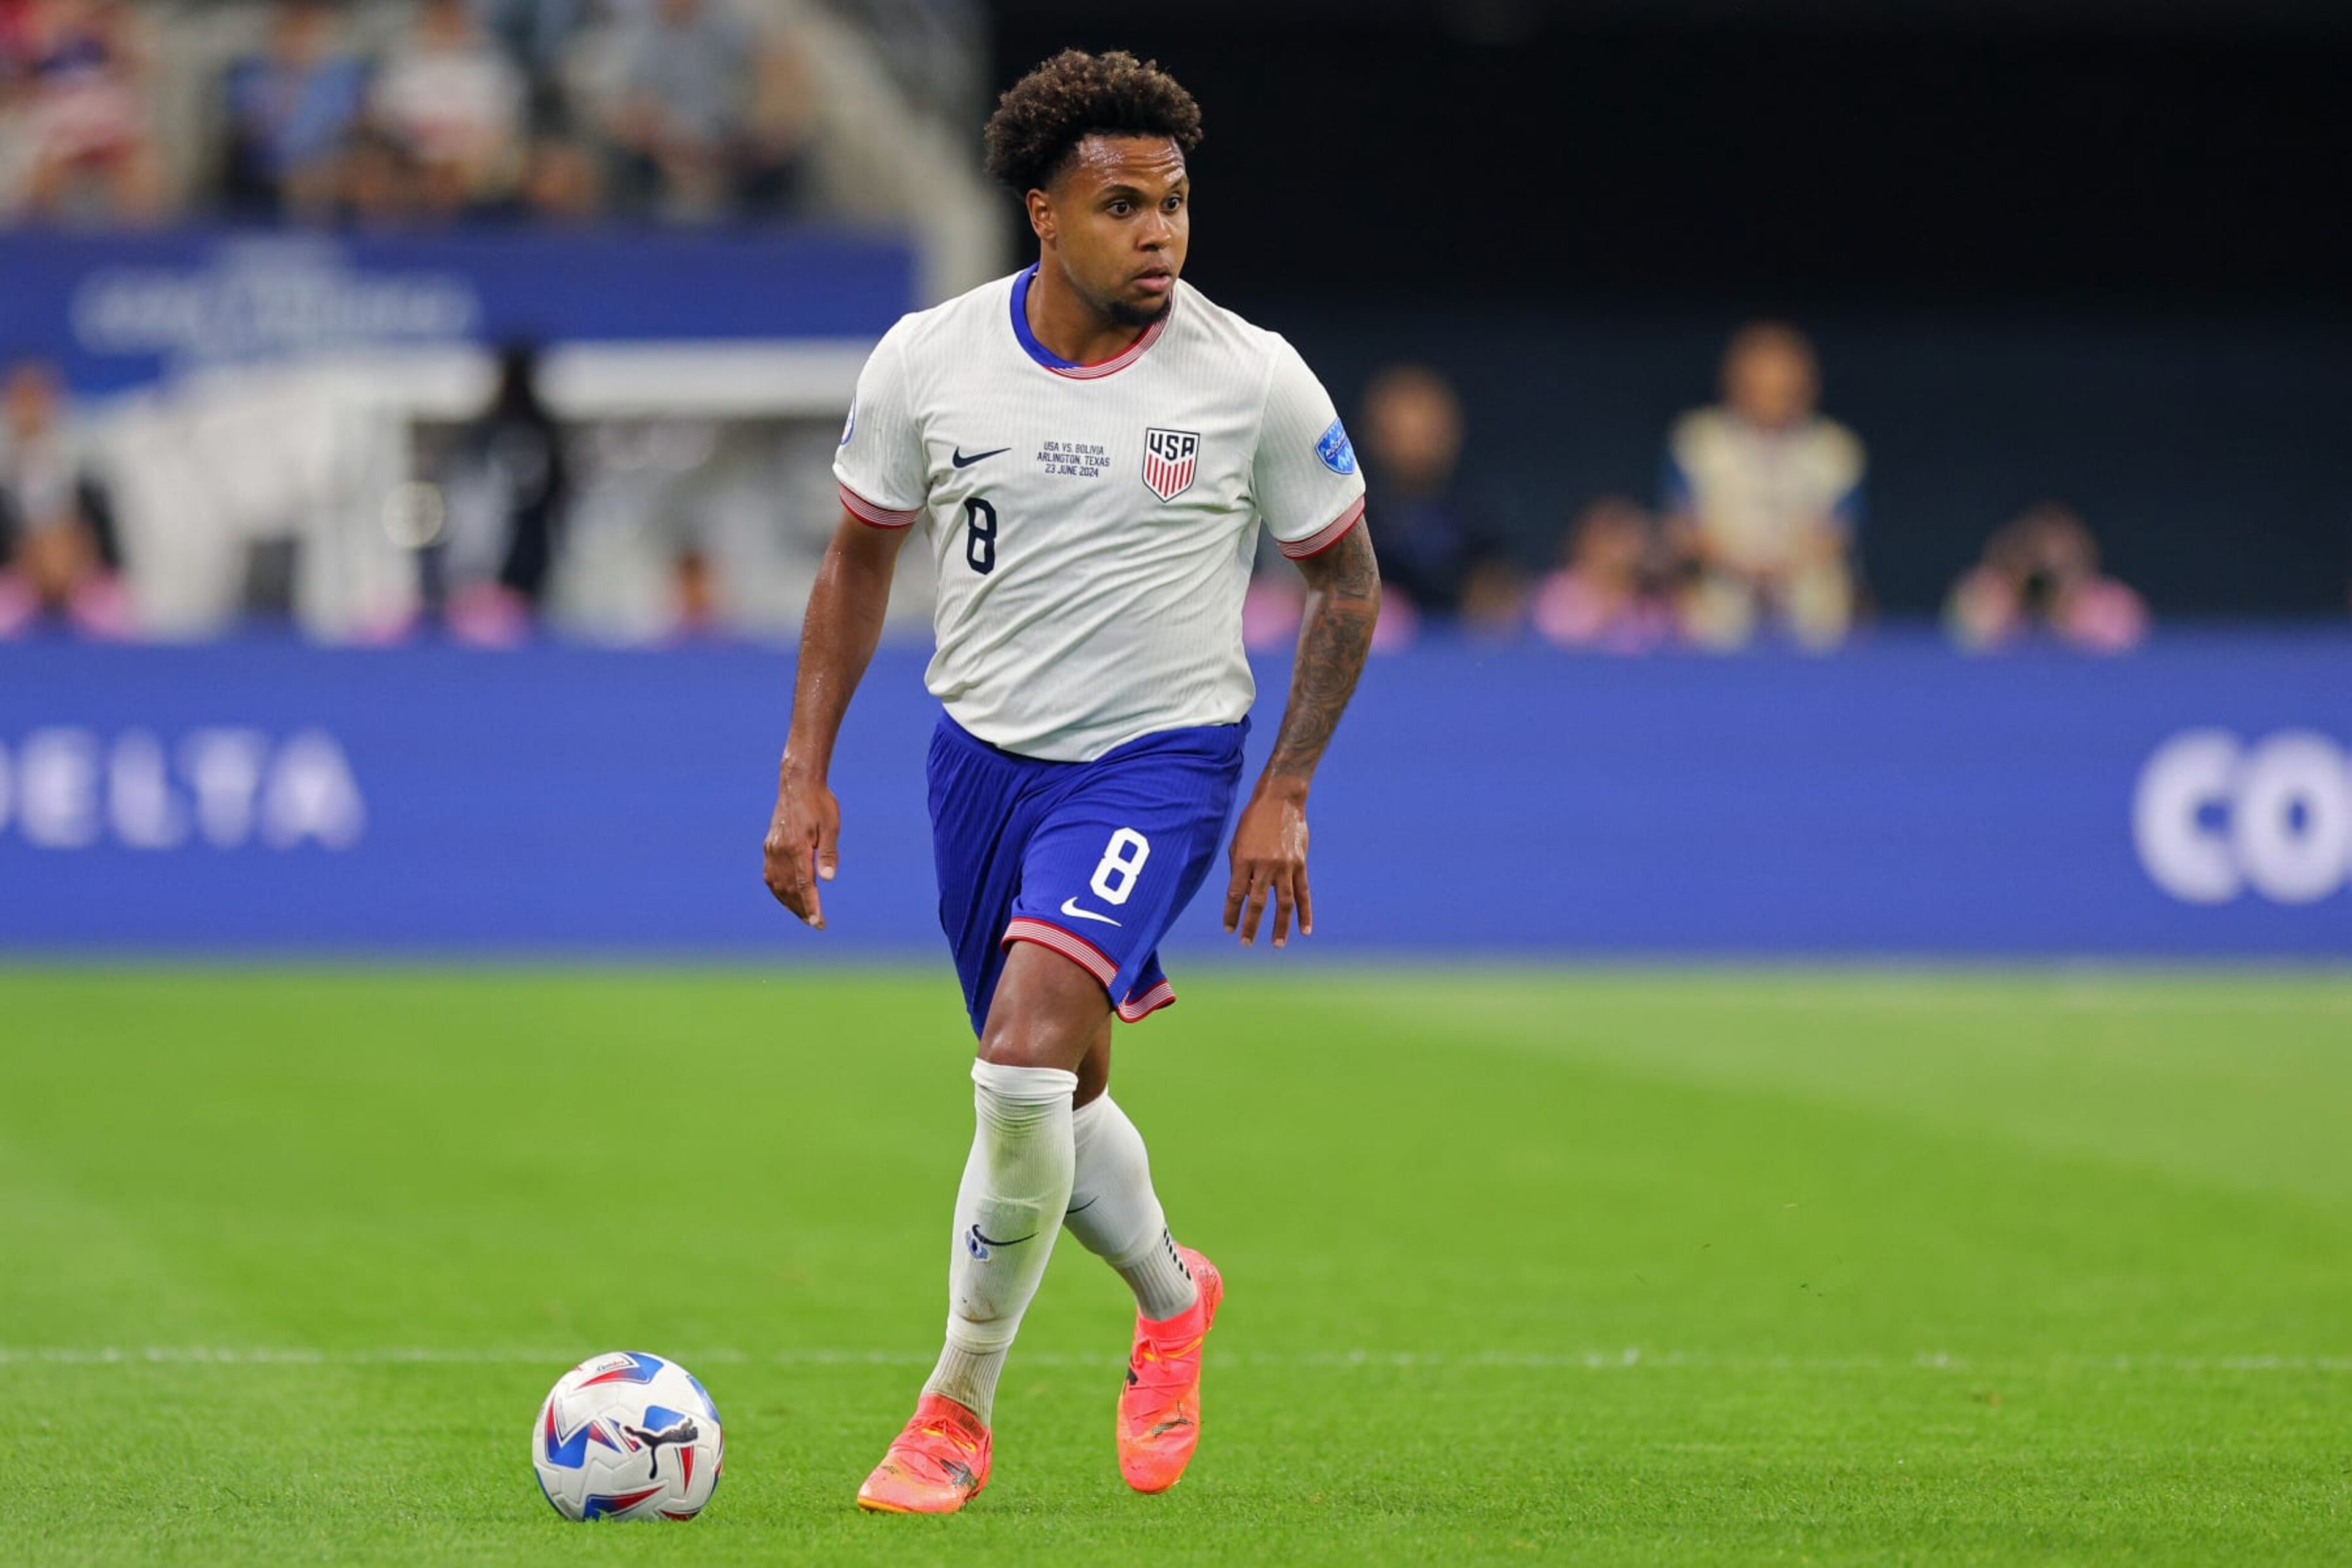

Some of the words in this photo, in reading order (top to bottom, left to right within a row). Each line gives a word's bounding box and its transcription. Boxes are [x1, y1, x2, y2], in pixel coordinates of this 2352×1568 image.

[1044, 440, 1059, 452] USA
[1075, 443, 1104, 455] BOLIVIA
[1045, 464, 1055, 473] 23
[1057, 465, 1077, 475] JUNE
[1079, 466, 1099, 478] 2024
[1084, 455, 1110, 467] TEXAS
[1150, 433, 1195, 461] USA
[964, 497, 997, 575] 8
[0, 726, 368, 850] ELTA
[2132, 728, 2352, 905] CO
[1090, 827, 1150, 905] 8
